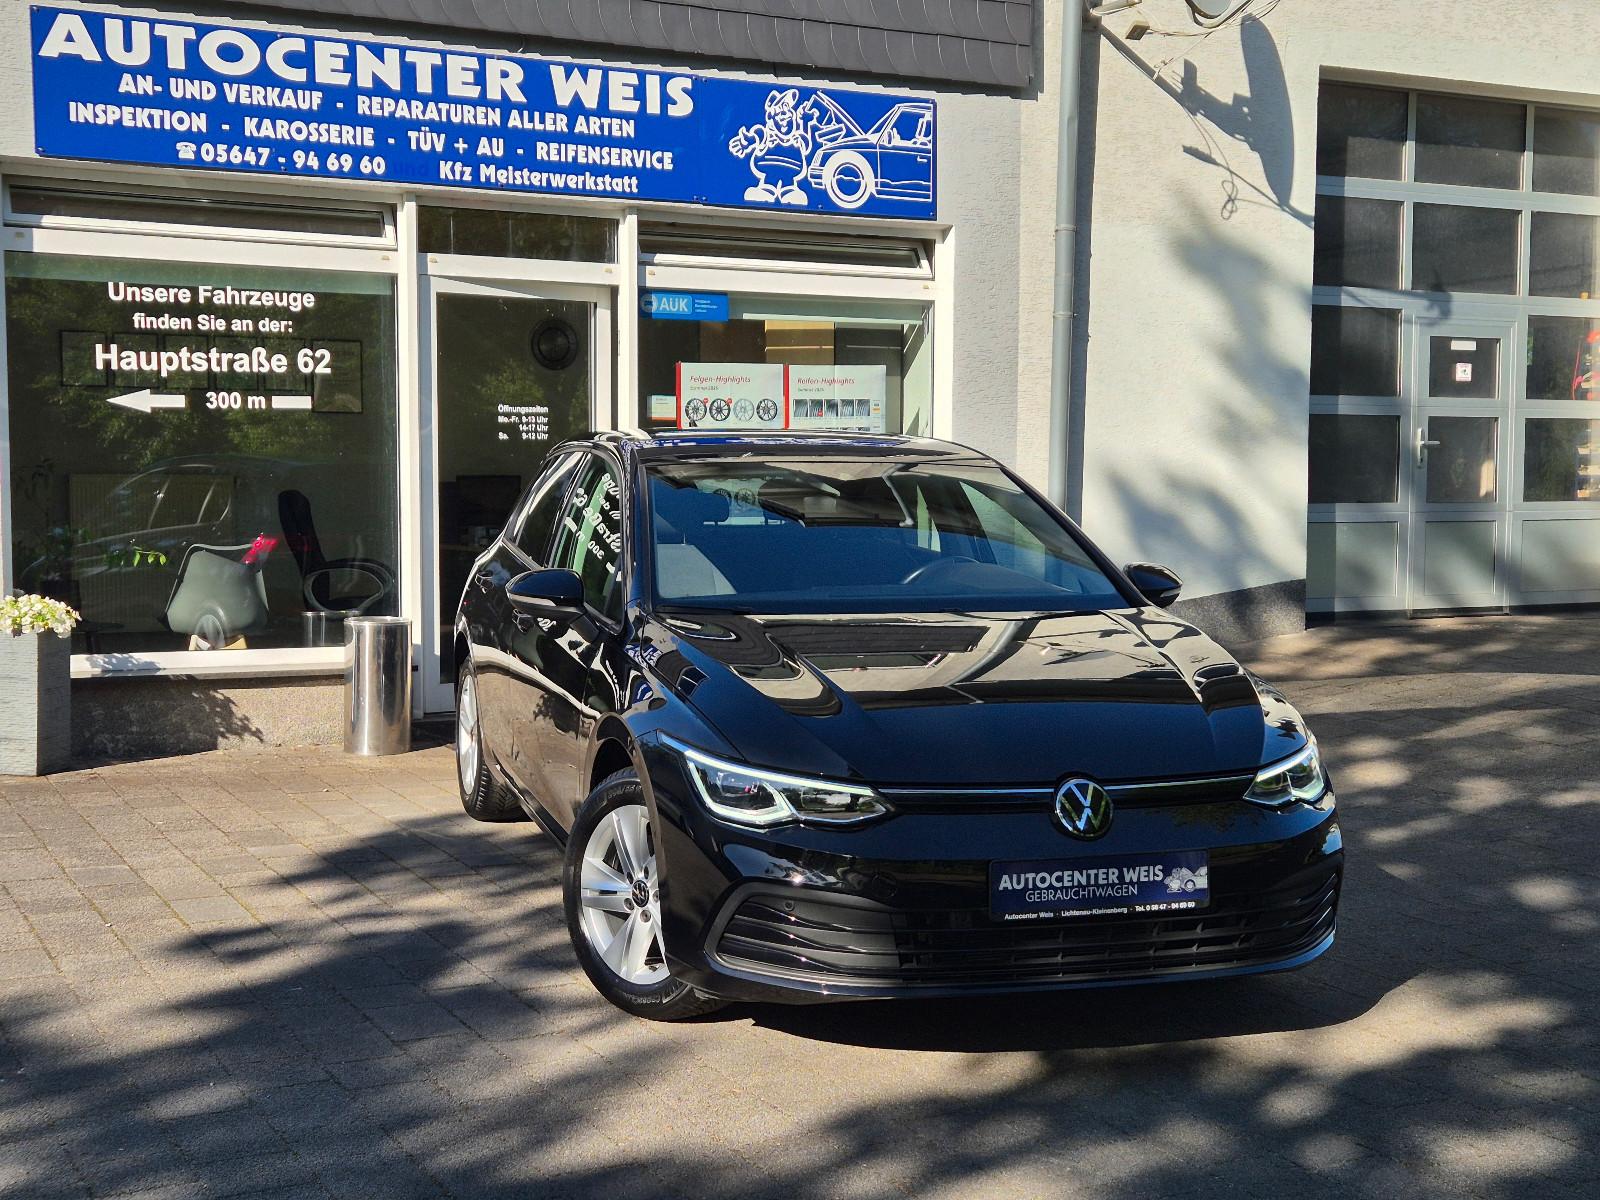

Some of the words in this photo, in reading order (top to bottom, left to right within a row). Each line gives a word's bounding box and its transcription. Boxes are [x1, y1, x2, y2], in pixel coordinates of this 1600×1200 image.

[39, 13, 525, 104] AUTOCENTER
[550, 63, 694, 117] WEIS
[119, 73, 162, 95] AN-
[170, 77, 217, 101] UND
[223, 83, 323, 111] VERKAUF
[357, 95, 501, 127] REPARATUREN
[508, 109, 569, 132] ALLER
[575, 115, 636, 138] ARTEN
[69, 102, 207, 134] INSPEKTION
[244, 117, 375, 147] KAROSSERIE
[408, 128, 446, 154] TÜV
[477, 137, 504, 157] AU
[536, 142, 674, 170] REIFENSERVICE
[200, 144, 271, 167] 05647
[293, 150, 324, 170] 94
[327, 153, 353, 173] 69
[360, 156, 386, 175] 60
[440, 160, 473, 182] Kfz
[480, 162, 639, 194] Meisterwerkstatt
[107, 281, 191, 303] Unsere
[198, 285, 315, 312] Fahrzeuge
[660, 297, 689, 313] AUK
[132, 312, 192, 330] finden
[197, 314, 226, 331] Sie
[231, 318, 253, 331] an
[258, 317, 293, 333] der:
[95, 343, 288, 377] Hauptstraße
[297, 348, 332, 374] 62
[205, 391, 242, 409] 300
[247, 395, 266, 409] m
[1000, 868, 1119, 891] AUTOCENTER
[1122, 864, 1164, 883] WEIS
[1025, 884, 1138, 902] GEBRAUCHTWAGEN
[1004, 912, 1038, 920] Autocenter
[1038, 910, 1054, 918] Weis
